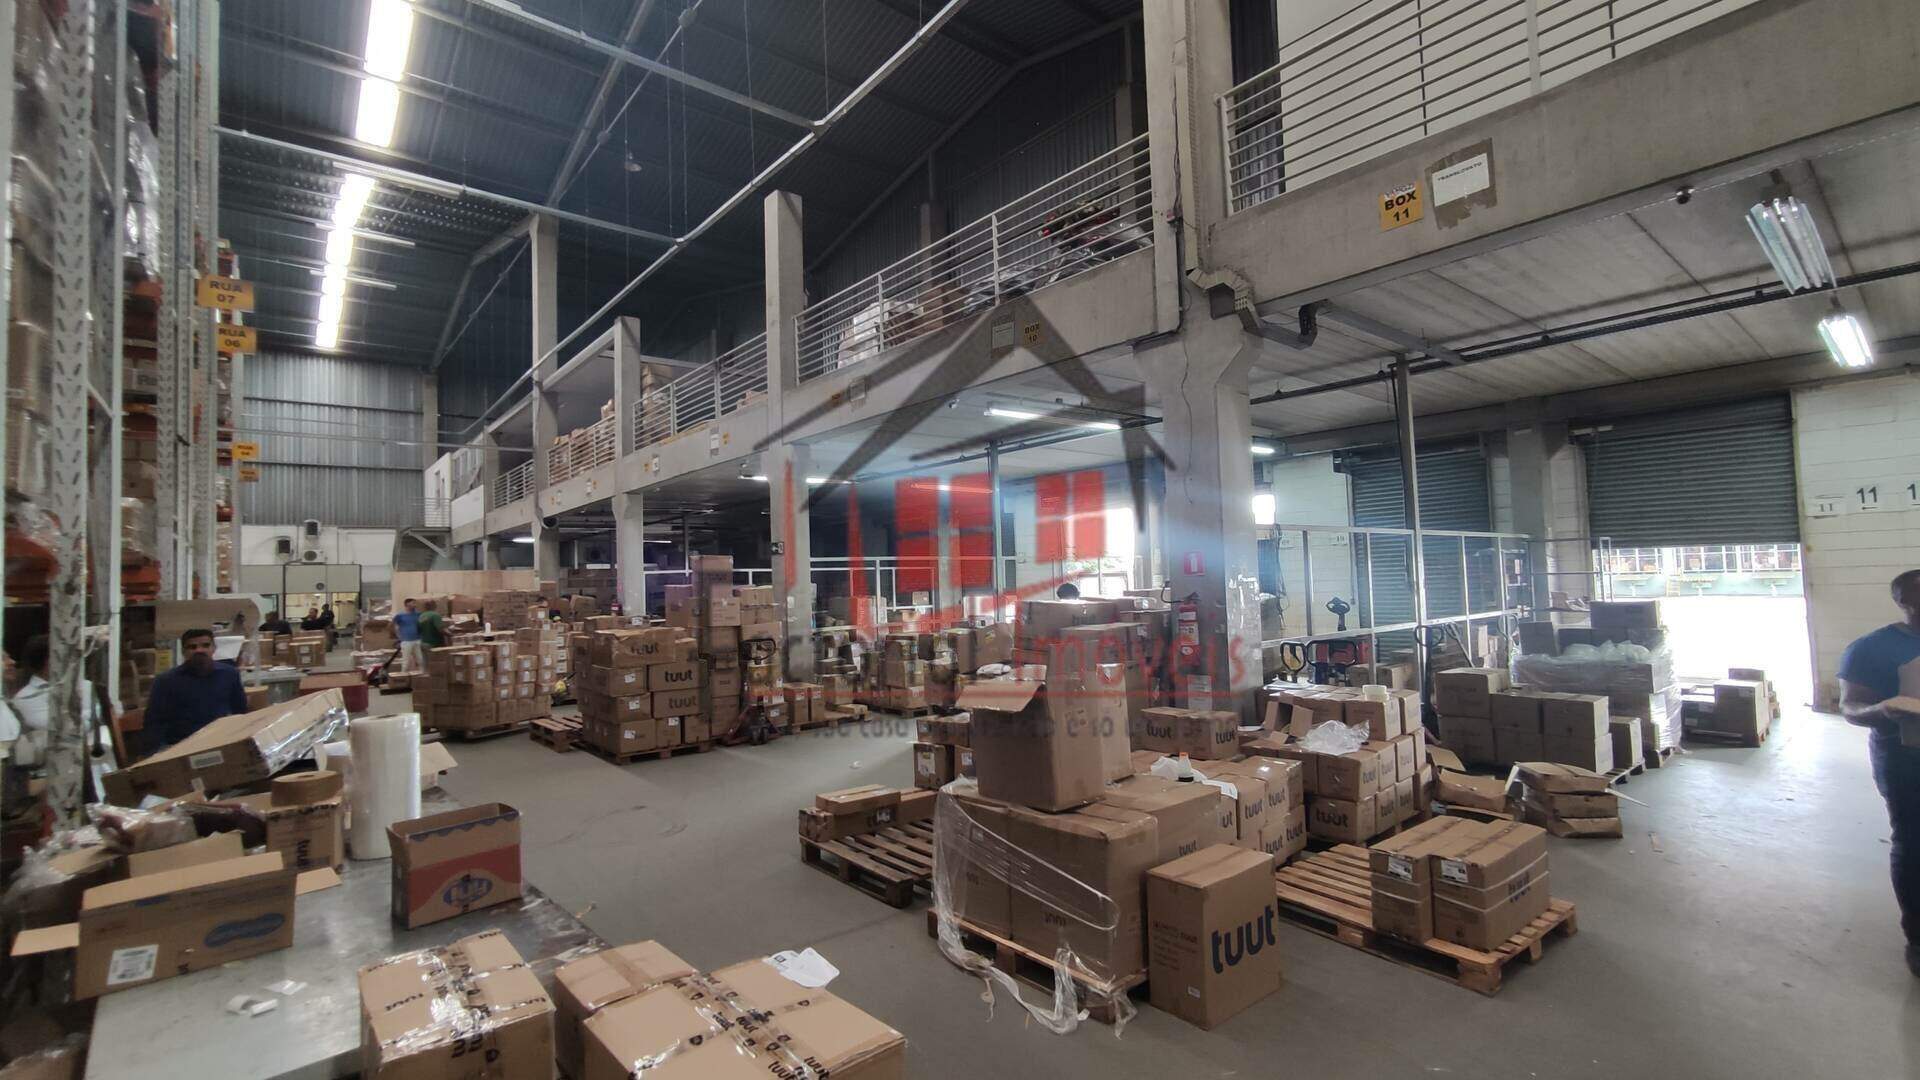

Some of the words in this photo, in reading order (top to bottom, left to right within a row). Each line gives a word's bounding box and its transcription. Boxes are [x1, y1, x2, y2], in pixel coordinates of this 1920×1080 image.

[1384, 190, 1416, 211] BOX
[1393, 208, 1409, 221] 11
[209, 280, 243, 293] RUA
[216, 294, 235, 303] 07
[218, 327, 247, 338] RUA
[1856, 486, 1878, 504] 11
[664, 669, 694, 683] tuut
[668, 696, 698, 709] tuut
[1146, 723, 1172, 739] tuut
[1215, 728, 1236, 744] tuut
[1245, 799, 1264, 819] tuut
[1315, 808, 1349, 828] tuut
[1286, 822, 1304, 840] tuut
[1177, 839, 1197, 857] tuut
[1265, 835, 1283, 853] tuut
[1211, 904, 1276, 975] tuut
